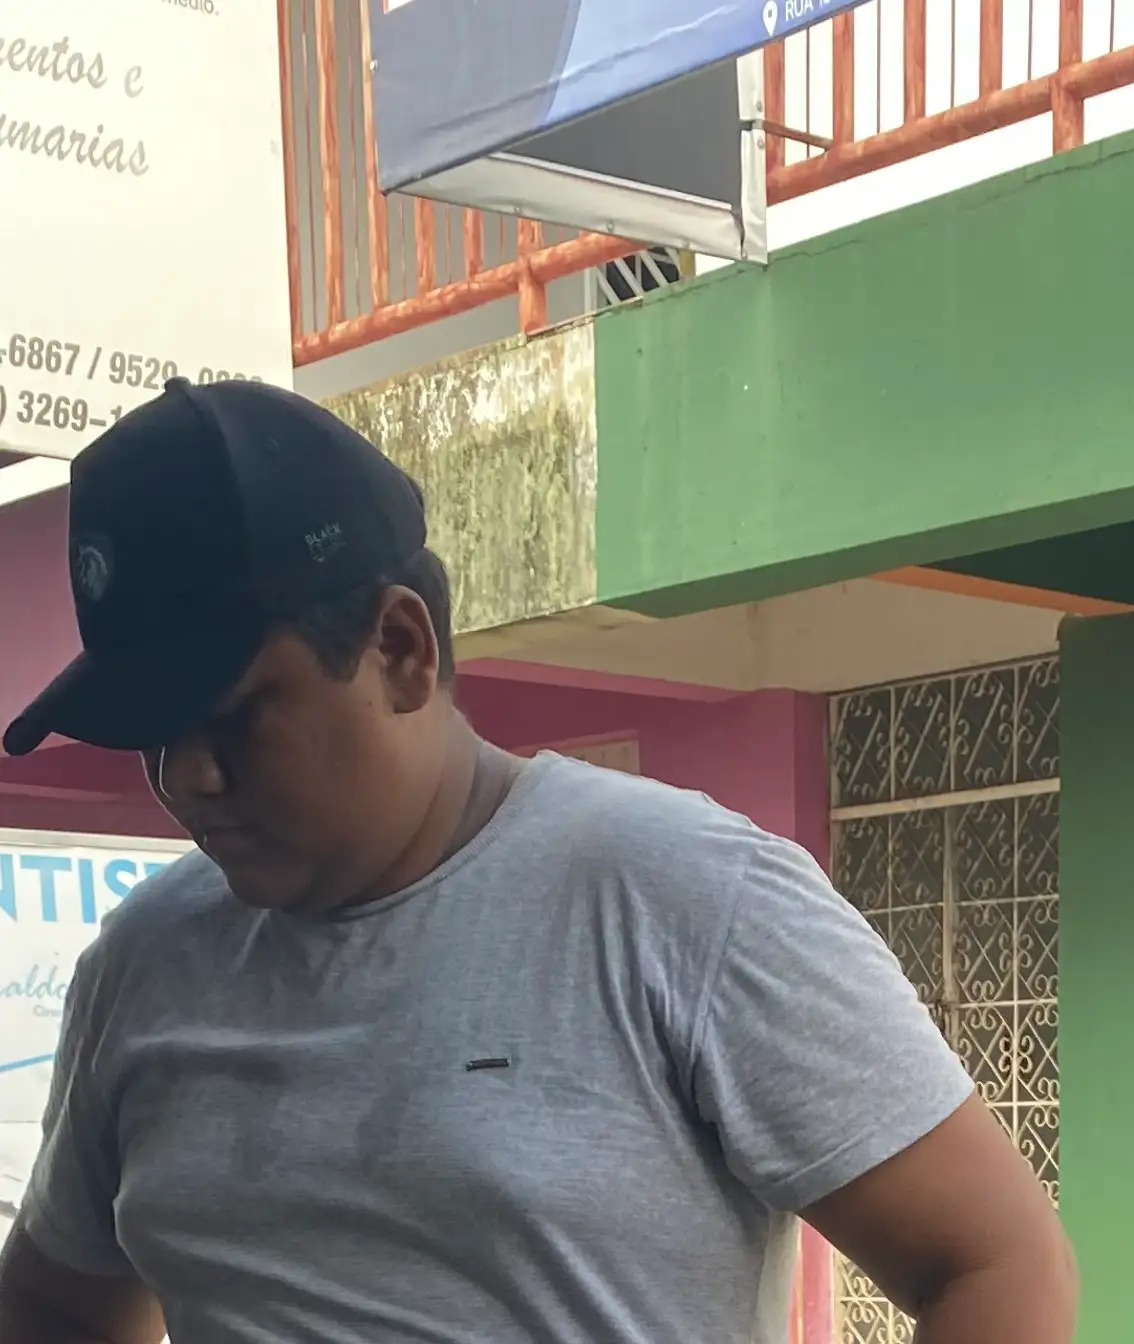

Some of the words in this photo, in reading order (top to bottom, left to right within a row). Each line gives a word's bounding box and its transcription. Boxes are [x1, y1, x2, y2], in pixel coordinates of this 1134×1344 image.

[0, 36, 107, 89] entos
[124, 65, 144, 98] e
[87, 347, 102, 380] /
[0, 854, 171, 924] TIS
